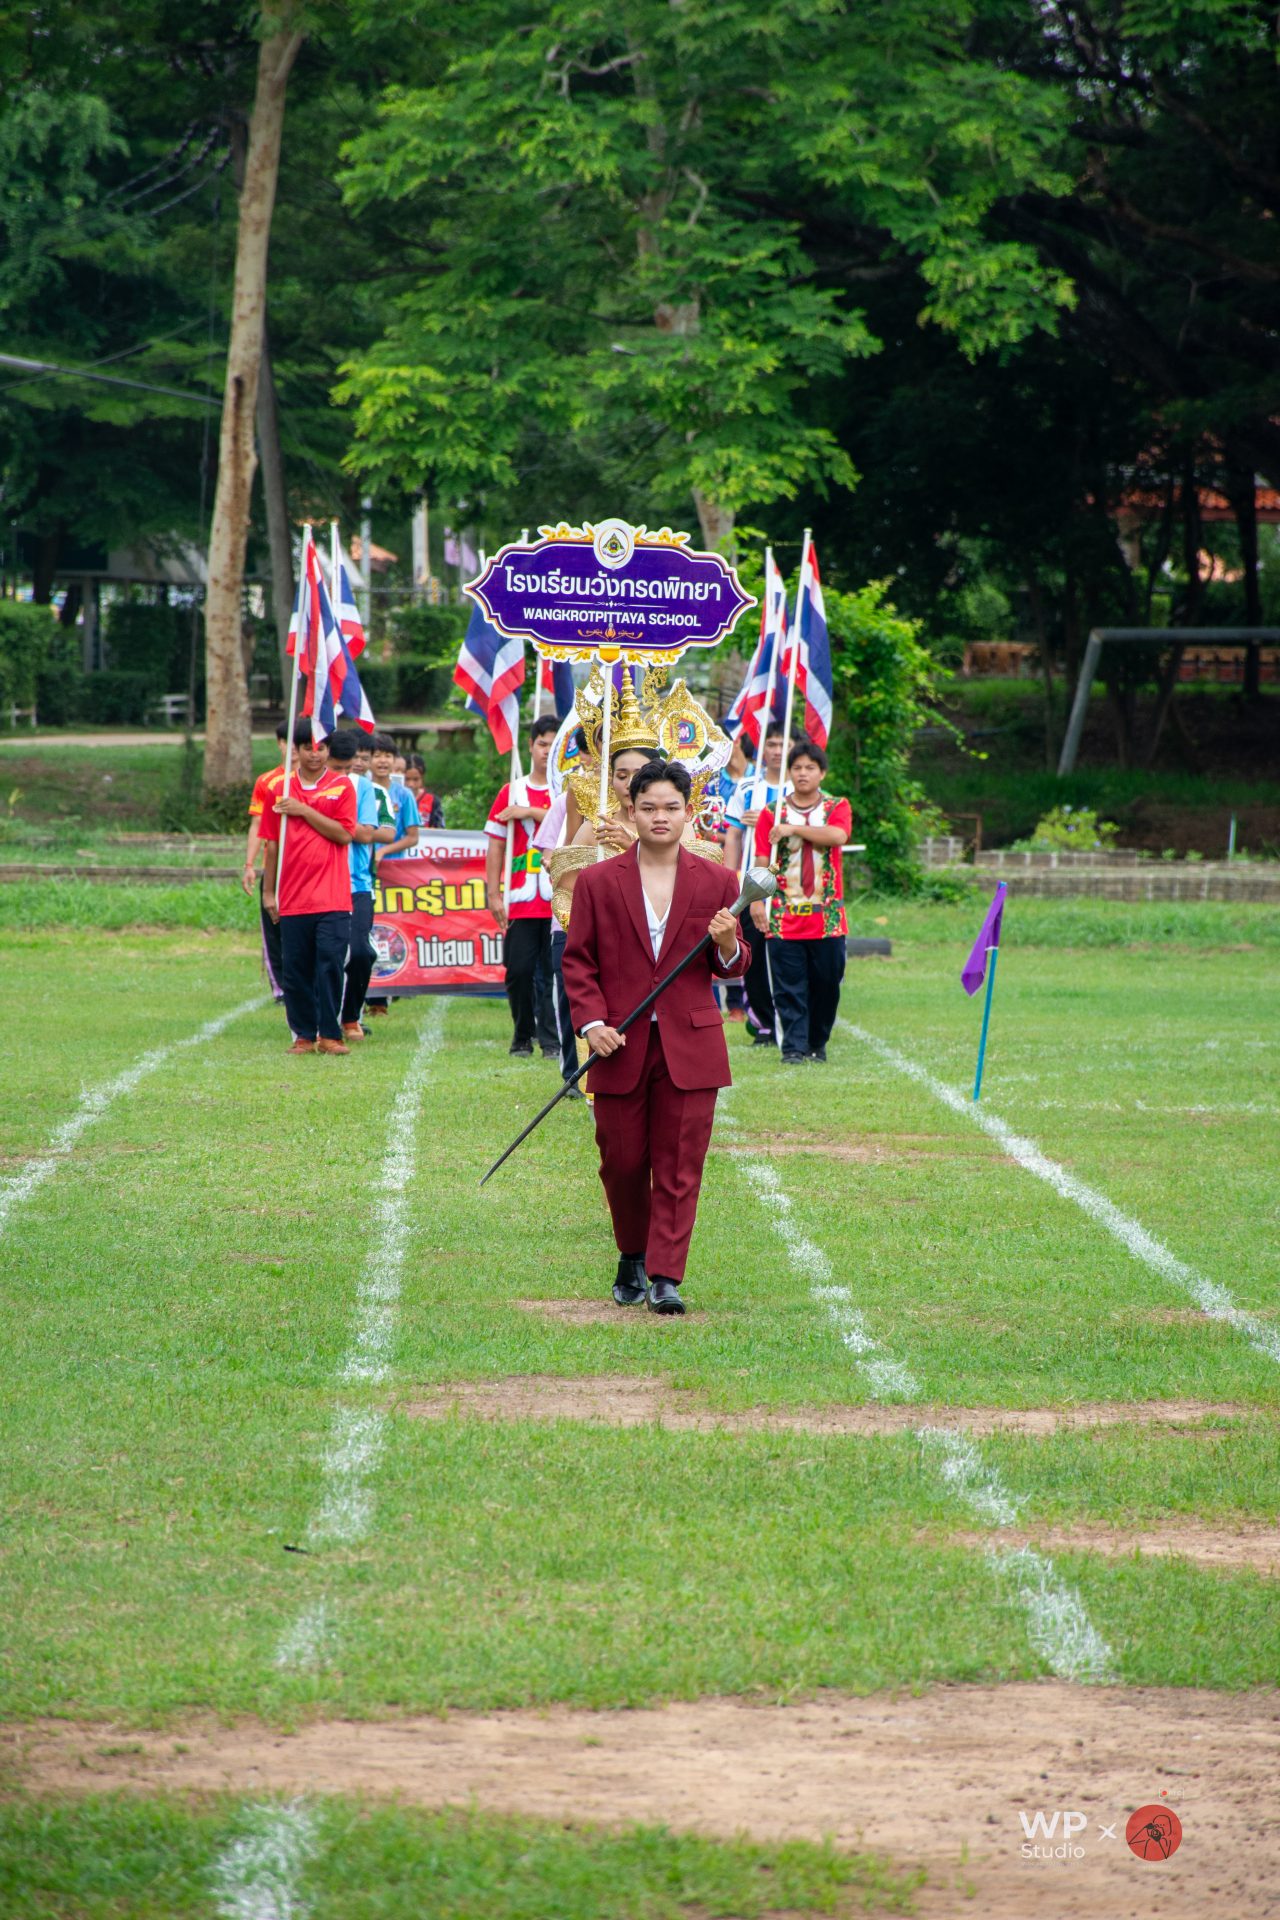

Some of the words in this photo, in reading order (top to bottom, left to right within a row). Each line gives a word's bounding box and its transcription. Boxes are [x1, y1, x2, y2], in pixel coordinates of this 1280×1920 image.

[505, 566, 721, 602] โรงเรียนวังกรดพิทยา
[523, 608, 646, 625] WANGKROTPITTAYA
[648, 613, 701, 627] SCHOOL
[416, 935, 474, 967] ไม่เสพ
[480, 933, 504, 965] ไม่
